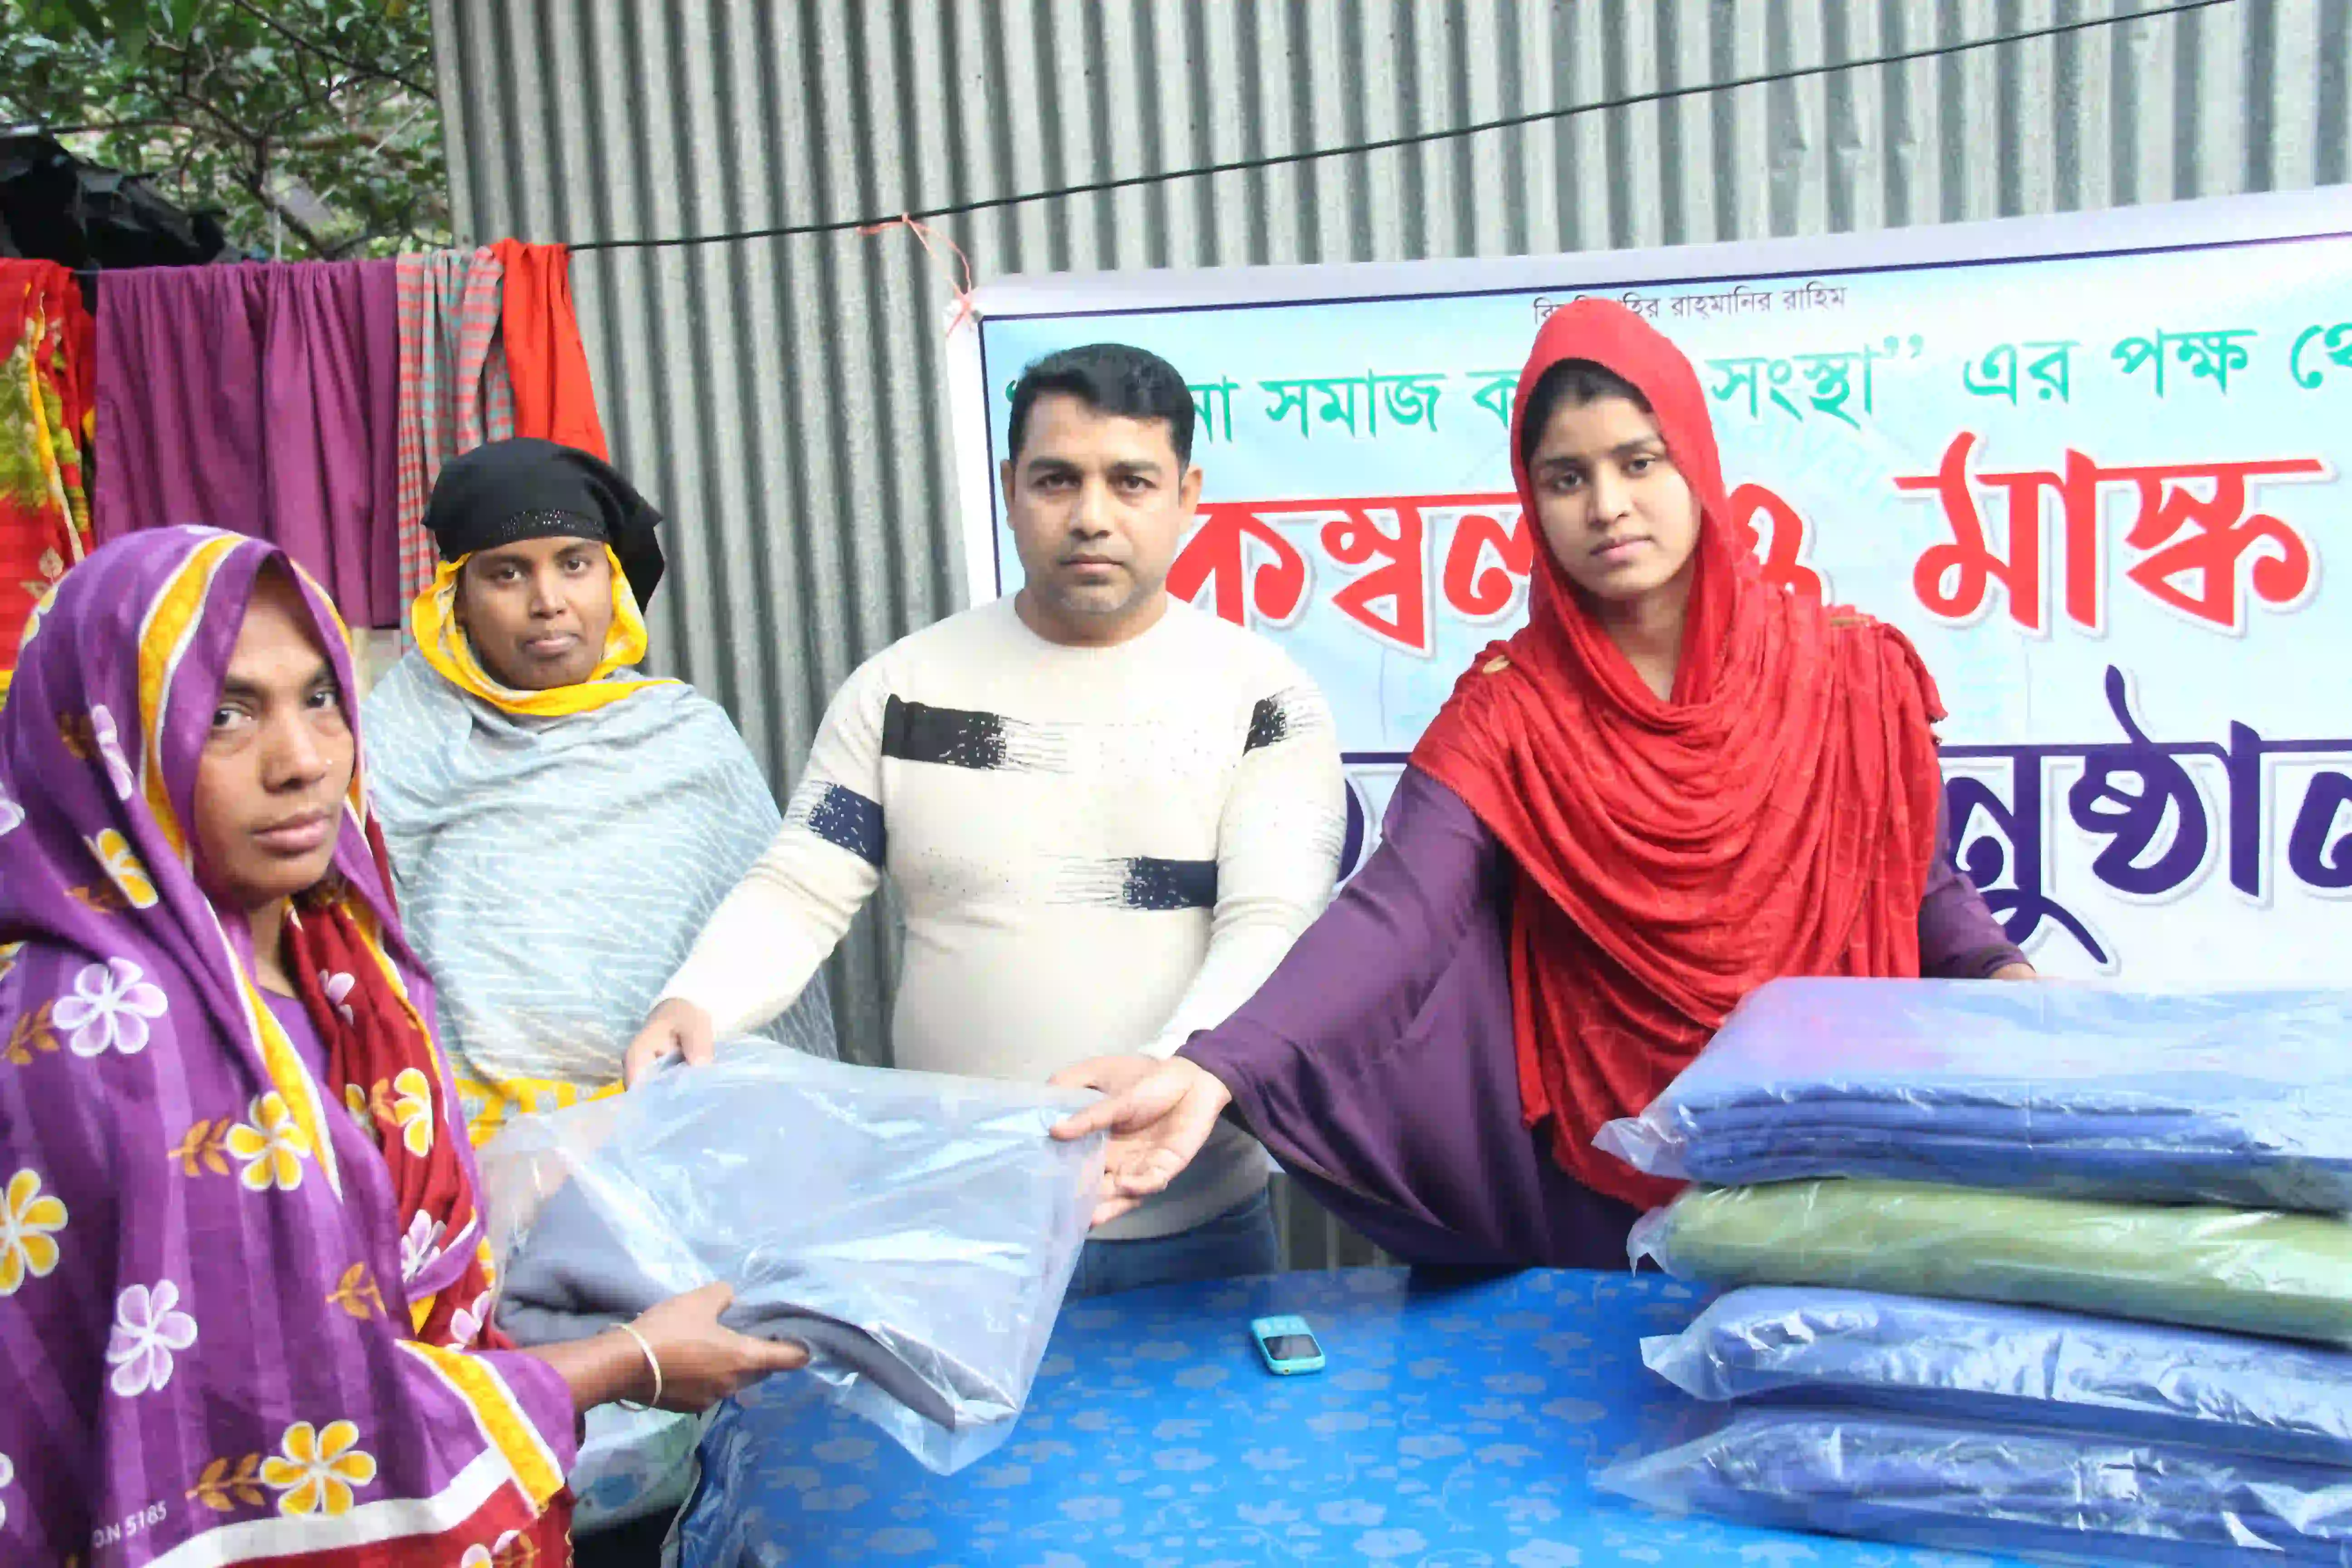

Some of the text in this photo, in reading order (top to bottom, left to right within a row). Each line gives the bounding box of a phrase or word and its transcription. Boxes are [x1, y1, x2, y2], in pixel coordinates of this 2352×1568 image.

[1783, 281, 1847, 311] রাহিম
[1258, 368, 1446, 439] সমাজ
[1963, 340, 2082, 406] এর
[2111, 327, 2259, 399] পক্ষ
[1892, 431, 2325, 631] মাস্ক
[124, 1499, 167, 1538] 5185
